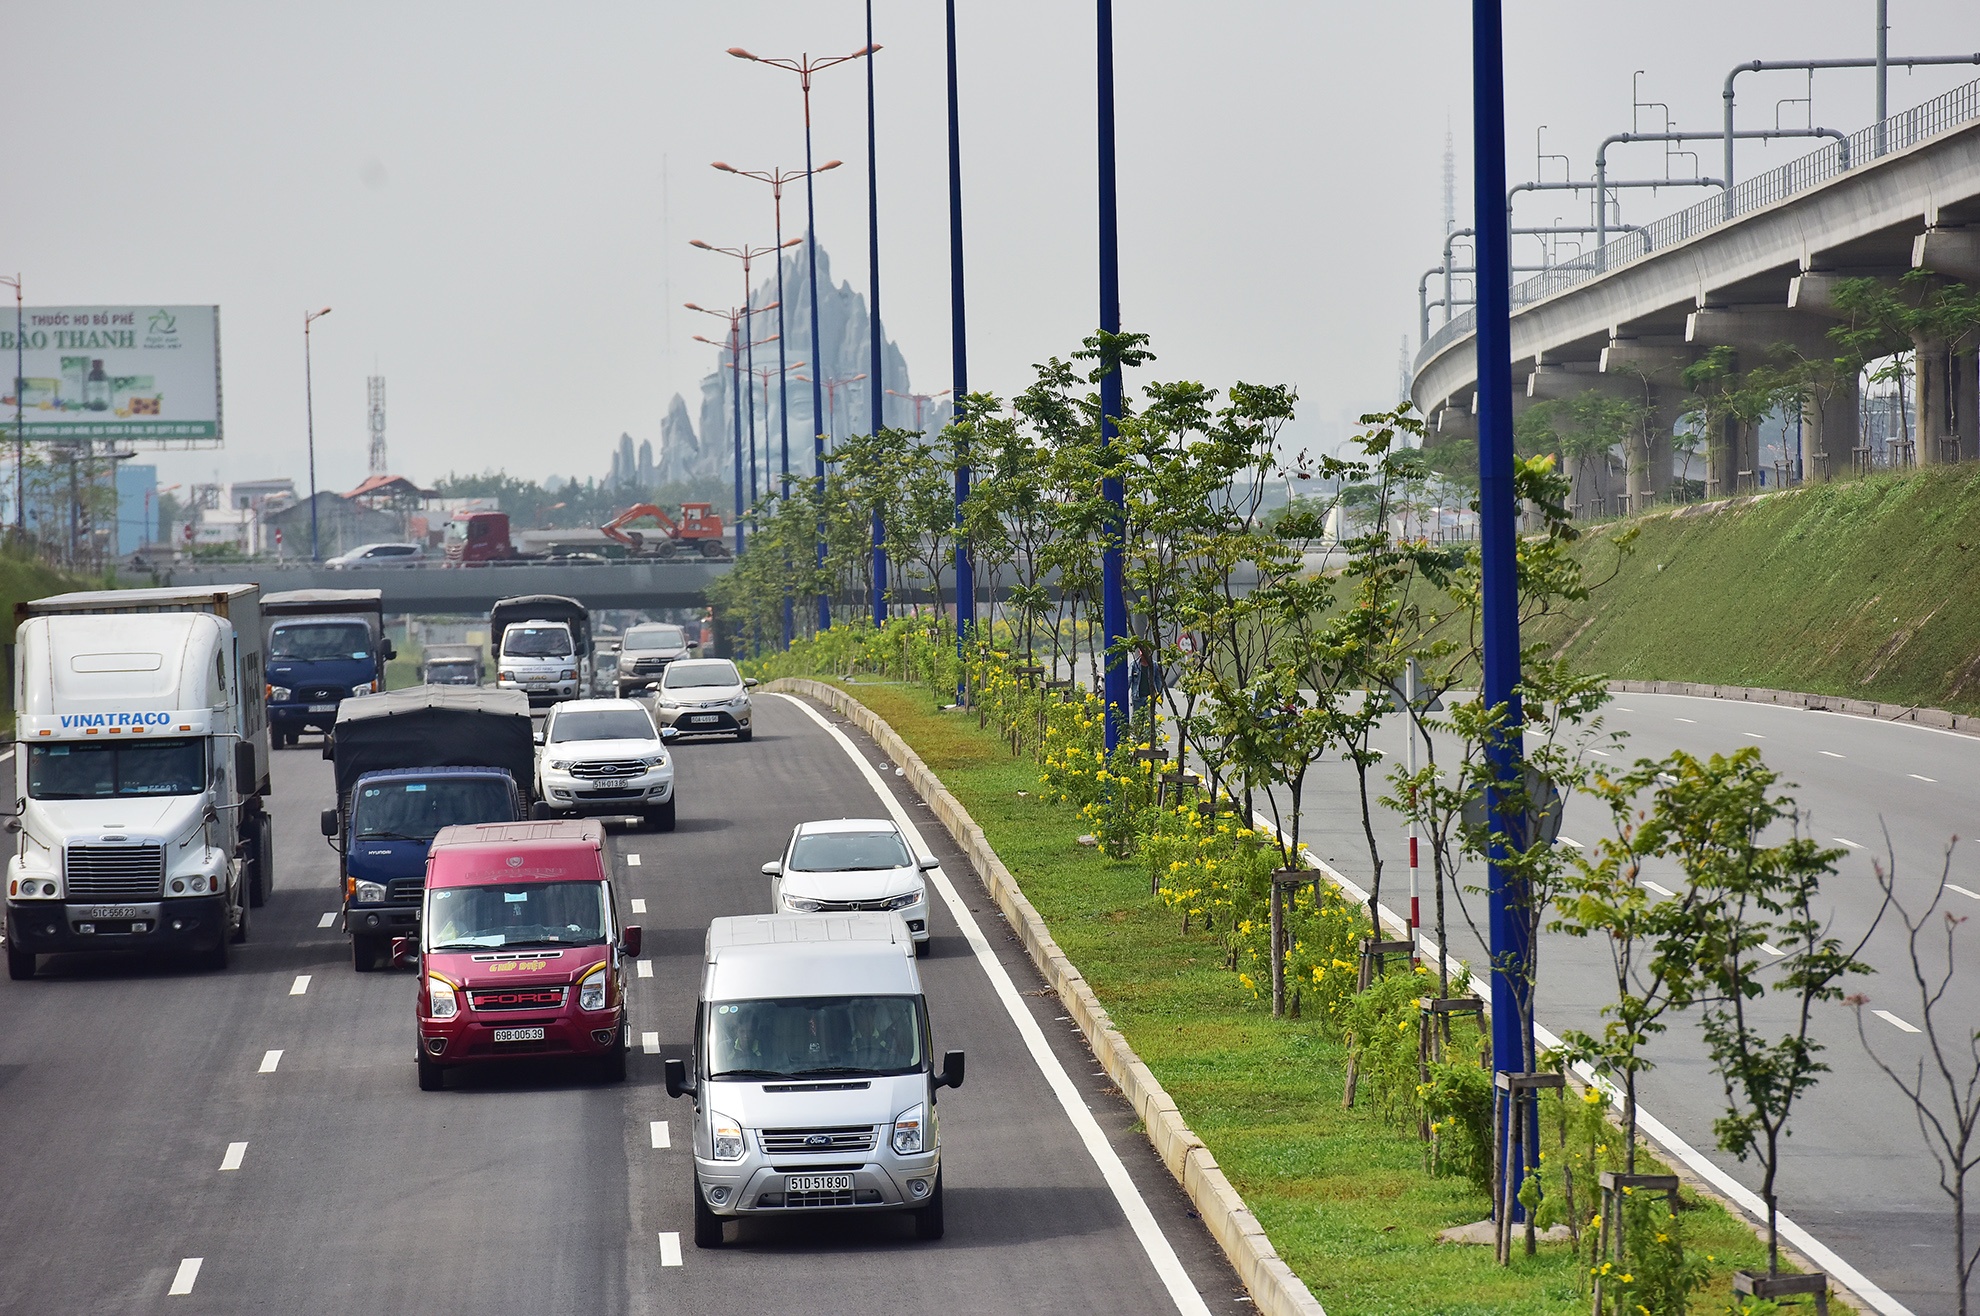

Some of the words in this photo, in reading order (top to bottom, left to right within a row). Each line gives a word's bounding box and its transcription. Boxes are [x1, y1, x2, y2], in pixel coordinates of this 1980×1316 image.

[74, 314, 90, 326] HO
[54, 329, 137, 349] THANH
[60, 712, 171, 728] VINATRACO
[476, 993, 559, 1005] FORD
[809, 1136, 826, 1145] Ford
[791, 1176, 848, 1190] 51D-518.90
